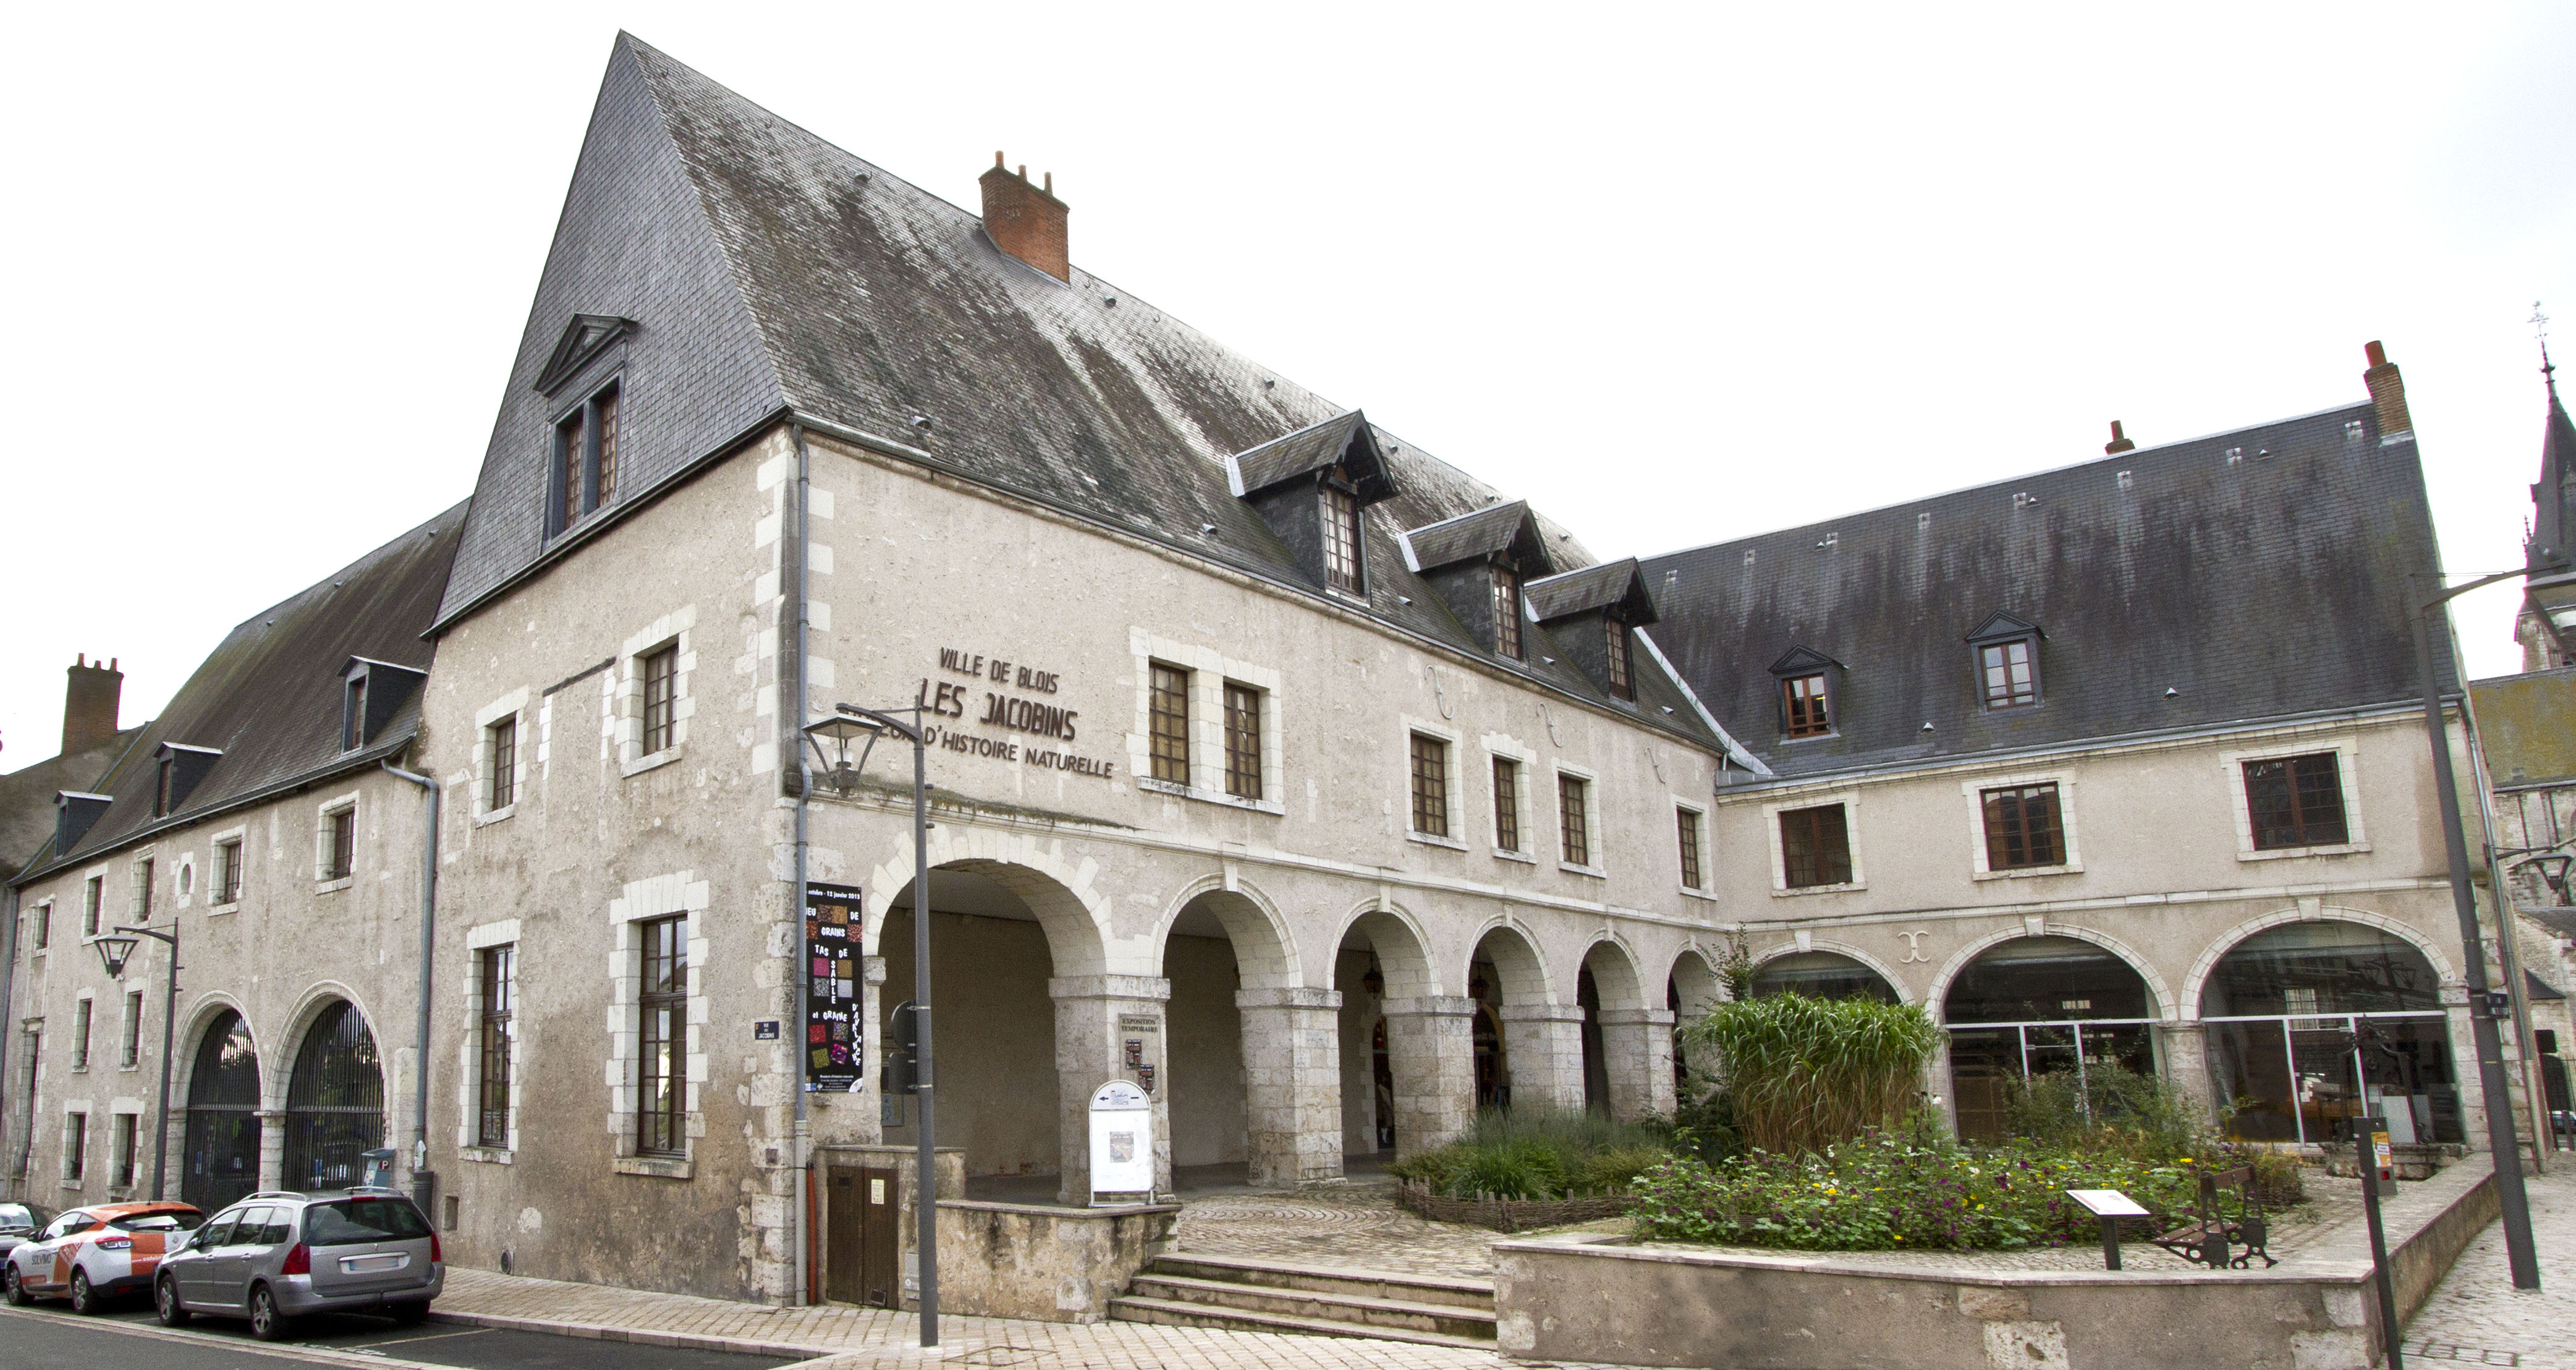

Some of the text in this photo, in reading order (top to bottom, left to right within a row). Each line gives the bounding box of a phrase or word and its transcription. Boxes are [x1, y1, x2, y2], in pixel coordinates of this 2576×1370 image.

[940, 647, 1060, 694] VILLE DE BLOIS
[920, 677, 1078, 742] LES JACOBINS
[924, 725, 1114, 779] D'HISTOIRE NATURELLE
[850, 911, 859, 921] DE
[821, 927, 845, 937] GRAINS
[815, 944, 848, 958] TAS DE
[823, 1010, 847, 1022] GRAINE
[382, 1160, 389, 1170] P
